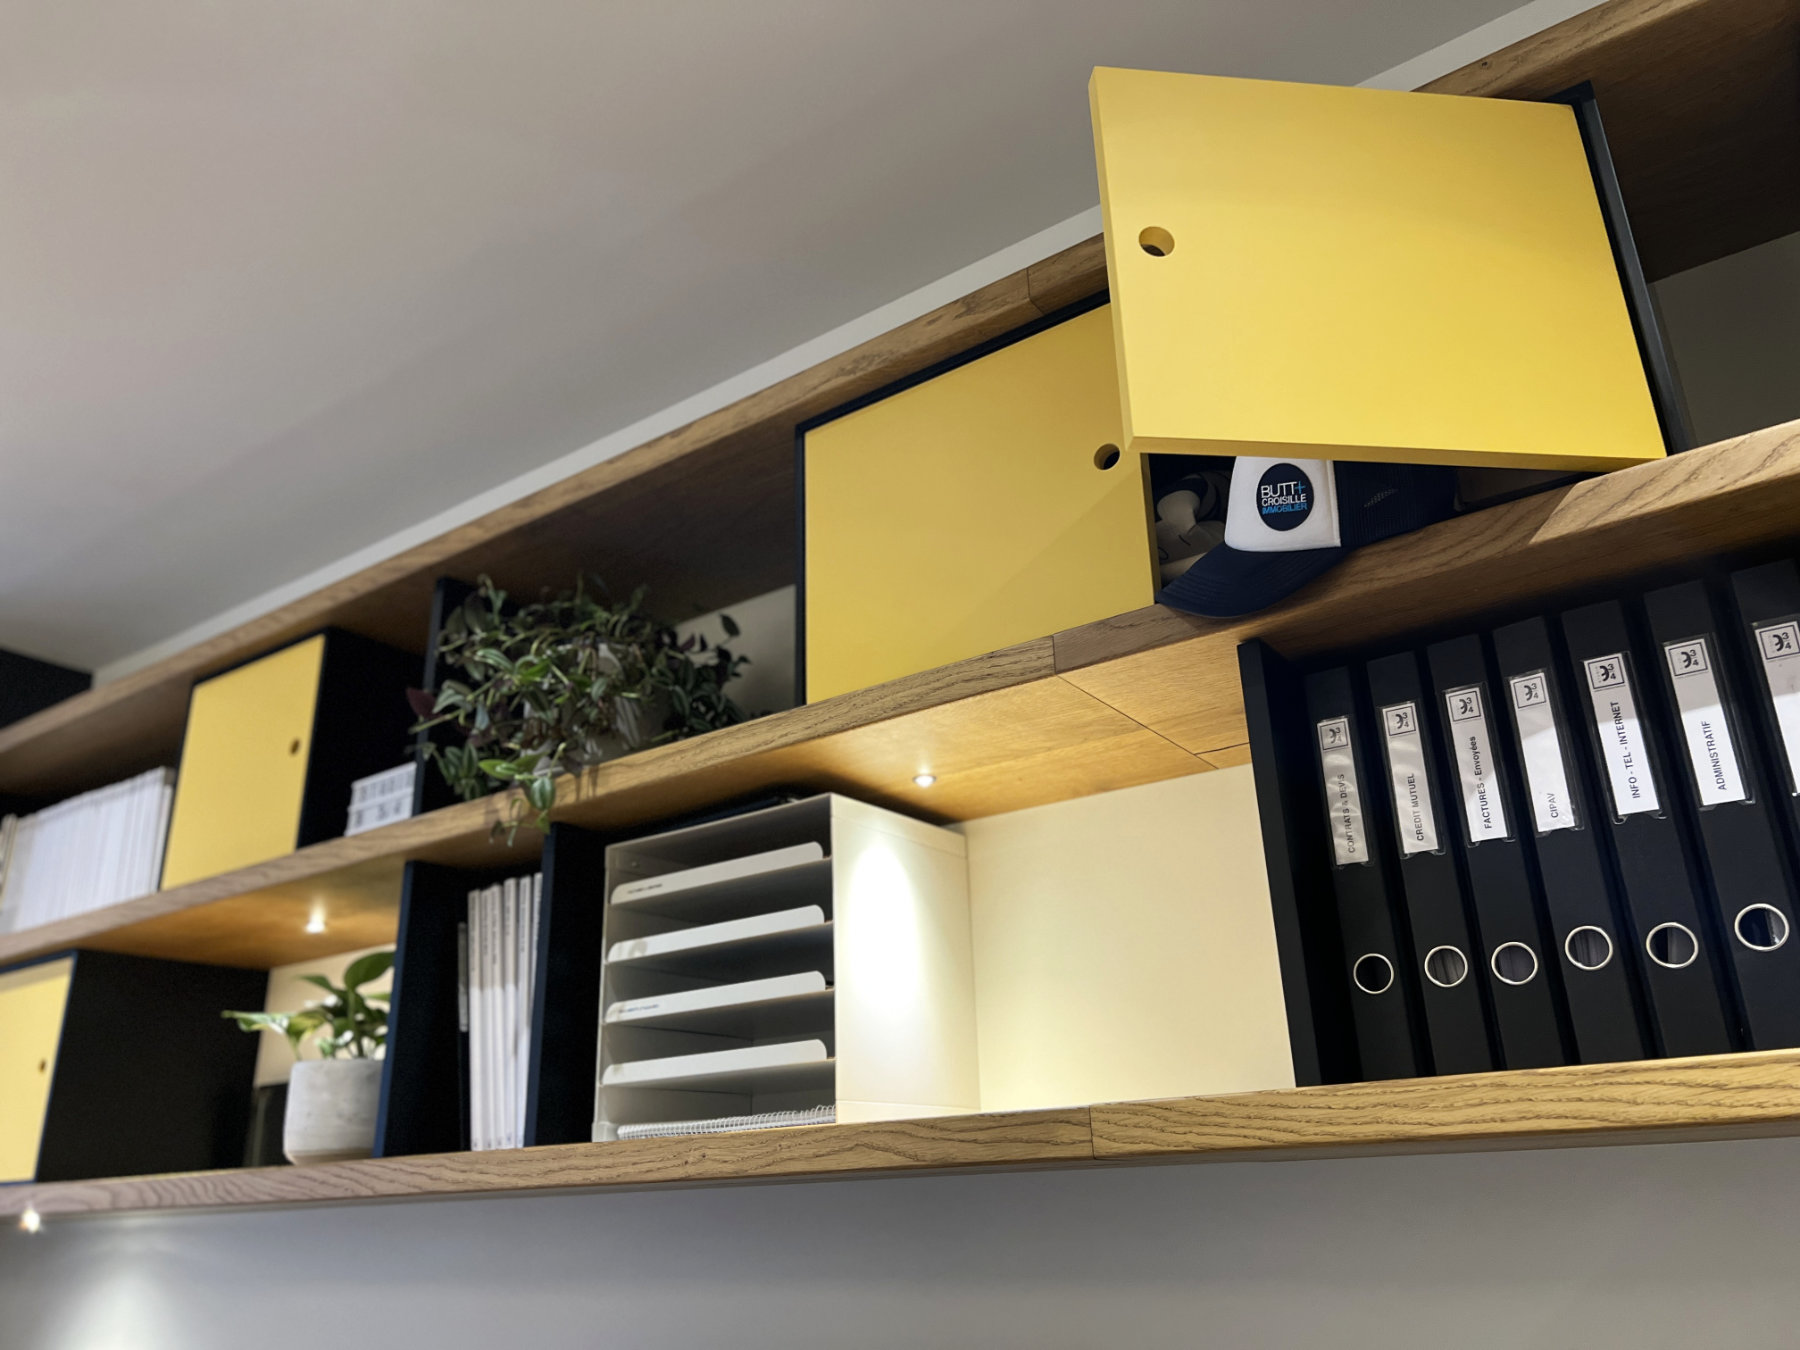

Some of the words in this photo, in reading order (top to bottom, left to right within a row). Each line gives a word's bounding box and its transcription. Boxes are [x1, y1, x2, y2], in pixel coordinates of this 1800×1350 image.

[1261, 493, 1307, 507] CROISILLE
[1262, 502, 1308, 515] IMMOBILIER
[1610, 701, 1628, 746] INTERNET
[1469, 736, 1482, 776] Envoyées
[1622, 752, 1634, 770] TEL
[1701, 720, 1727, 791] ADMINISTRATIF
[1407, 773, 1419, 808] MUTUEL
[1628, 776, 1641, 799] INFO
[1477, 782, 1492, 829] FACTURES
[1546, 793, 1559, 819] CIPAV
[1342, 808, 1356, 853] CONTRATS
[1413, 810, 1425, 841] CREDIT
